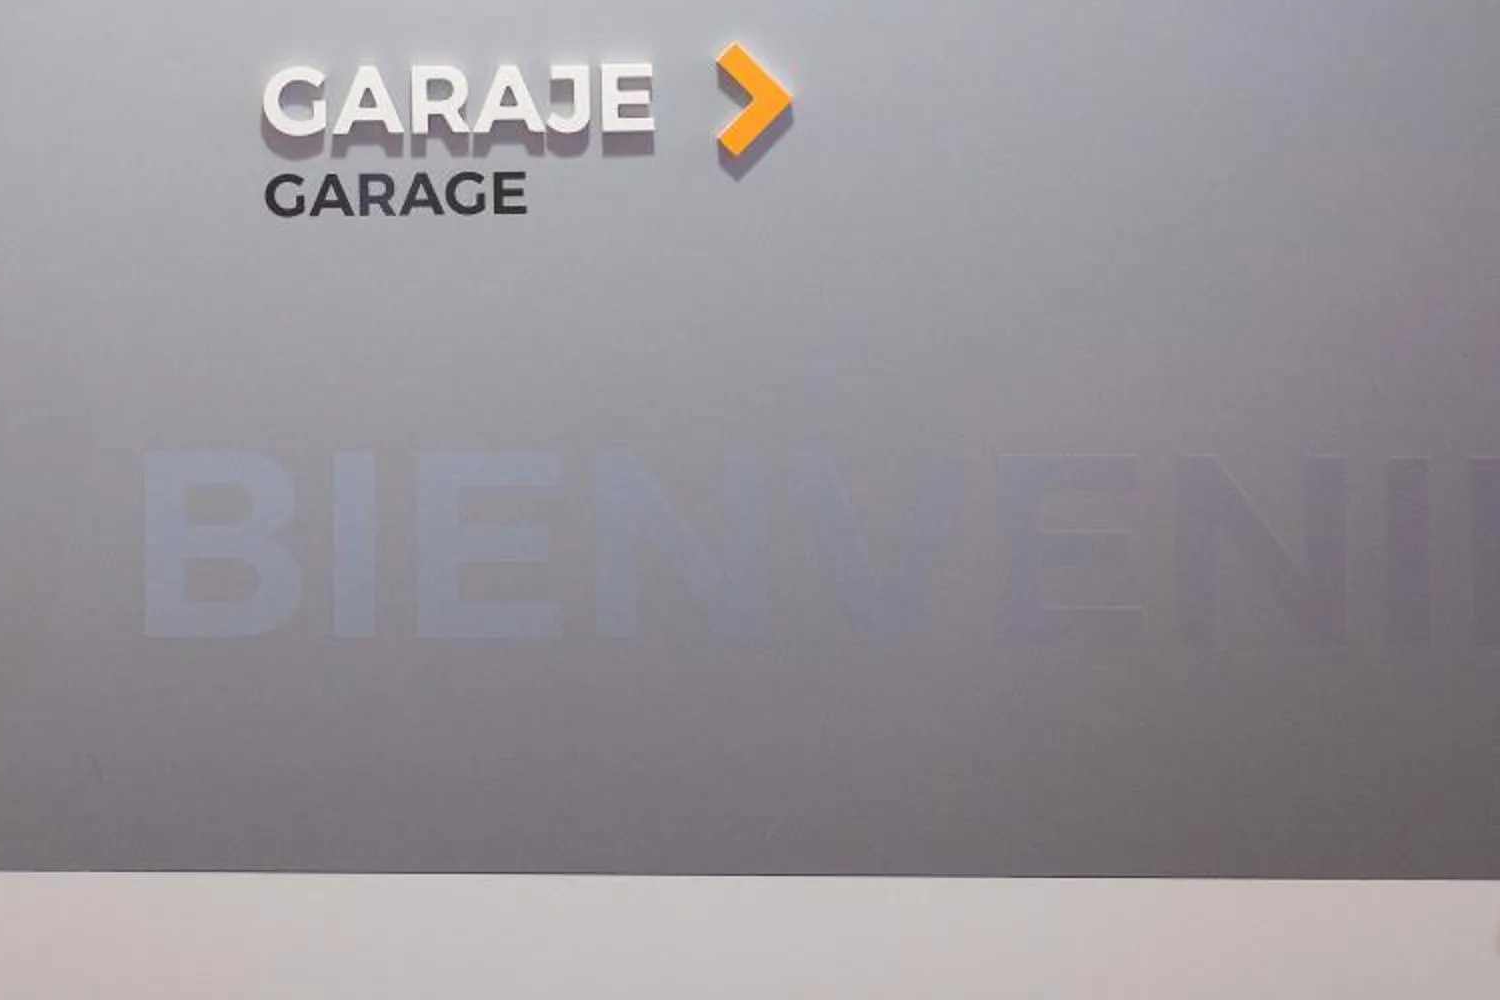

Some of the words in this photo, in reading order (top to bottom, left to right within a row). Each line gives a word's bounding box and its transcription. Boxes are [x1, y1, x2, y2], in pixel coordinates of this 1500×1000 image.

[262, 62, 655, 137] GARAJE
[264, 171, 528, 217] GARAGE
[142, 447, 1500, 648] BIENVENI
